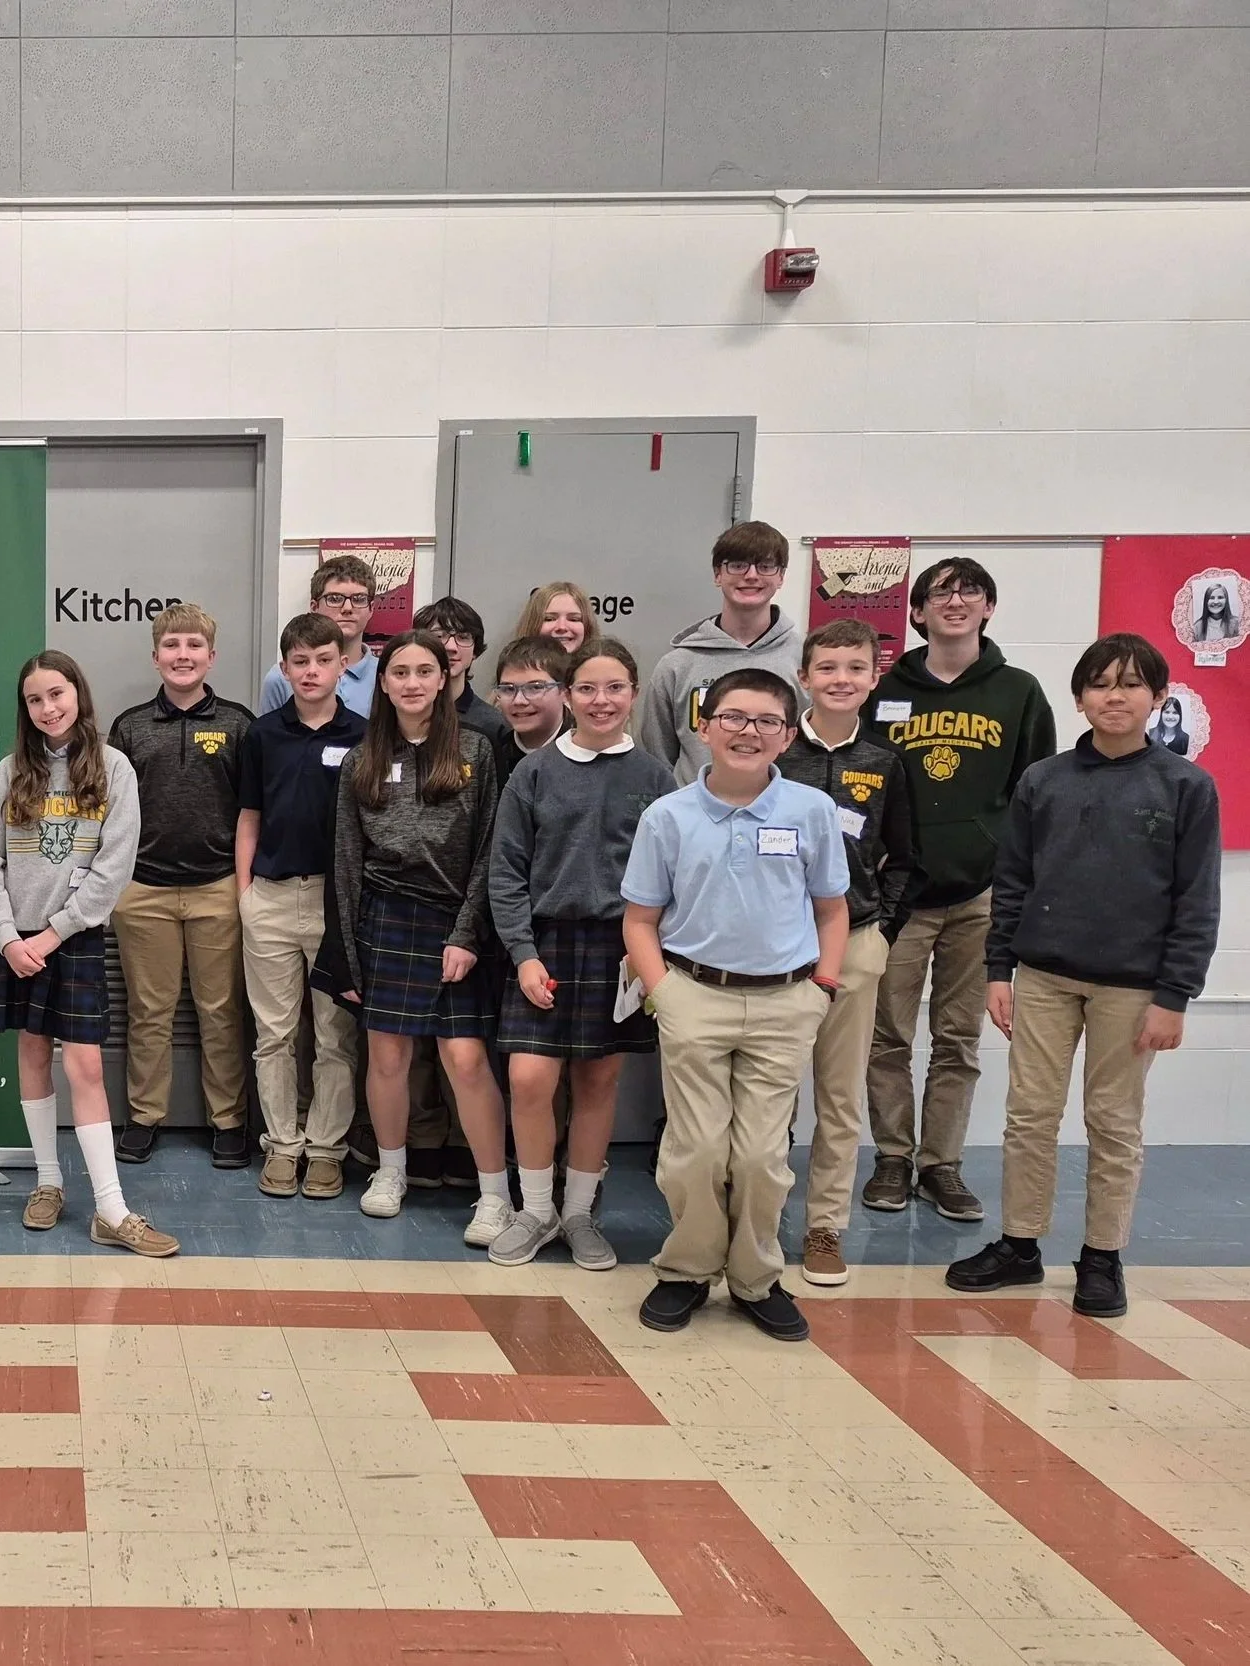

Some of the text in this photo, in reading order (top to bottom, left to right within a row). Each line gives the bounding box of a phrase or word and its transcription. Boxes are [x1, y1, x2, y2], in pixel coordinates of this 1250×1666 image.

[859, 552, 903, 576] Arsenic
[194, 731, 227, 745] COUGARS
[889, 711, 1002, 748] COUGARS
[841, 770, 884, 789] COUGARS
[761, 833, 791, 844] Zander
